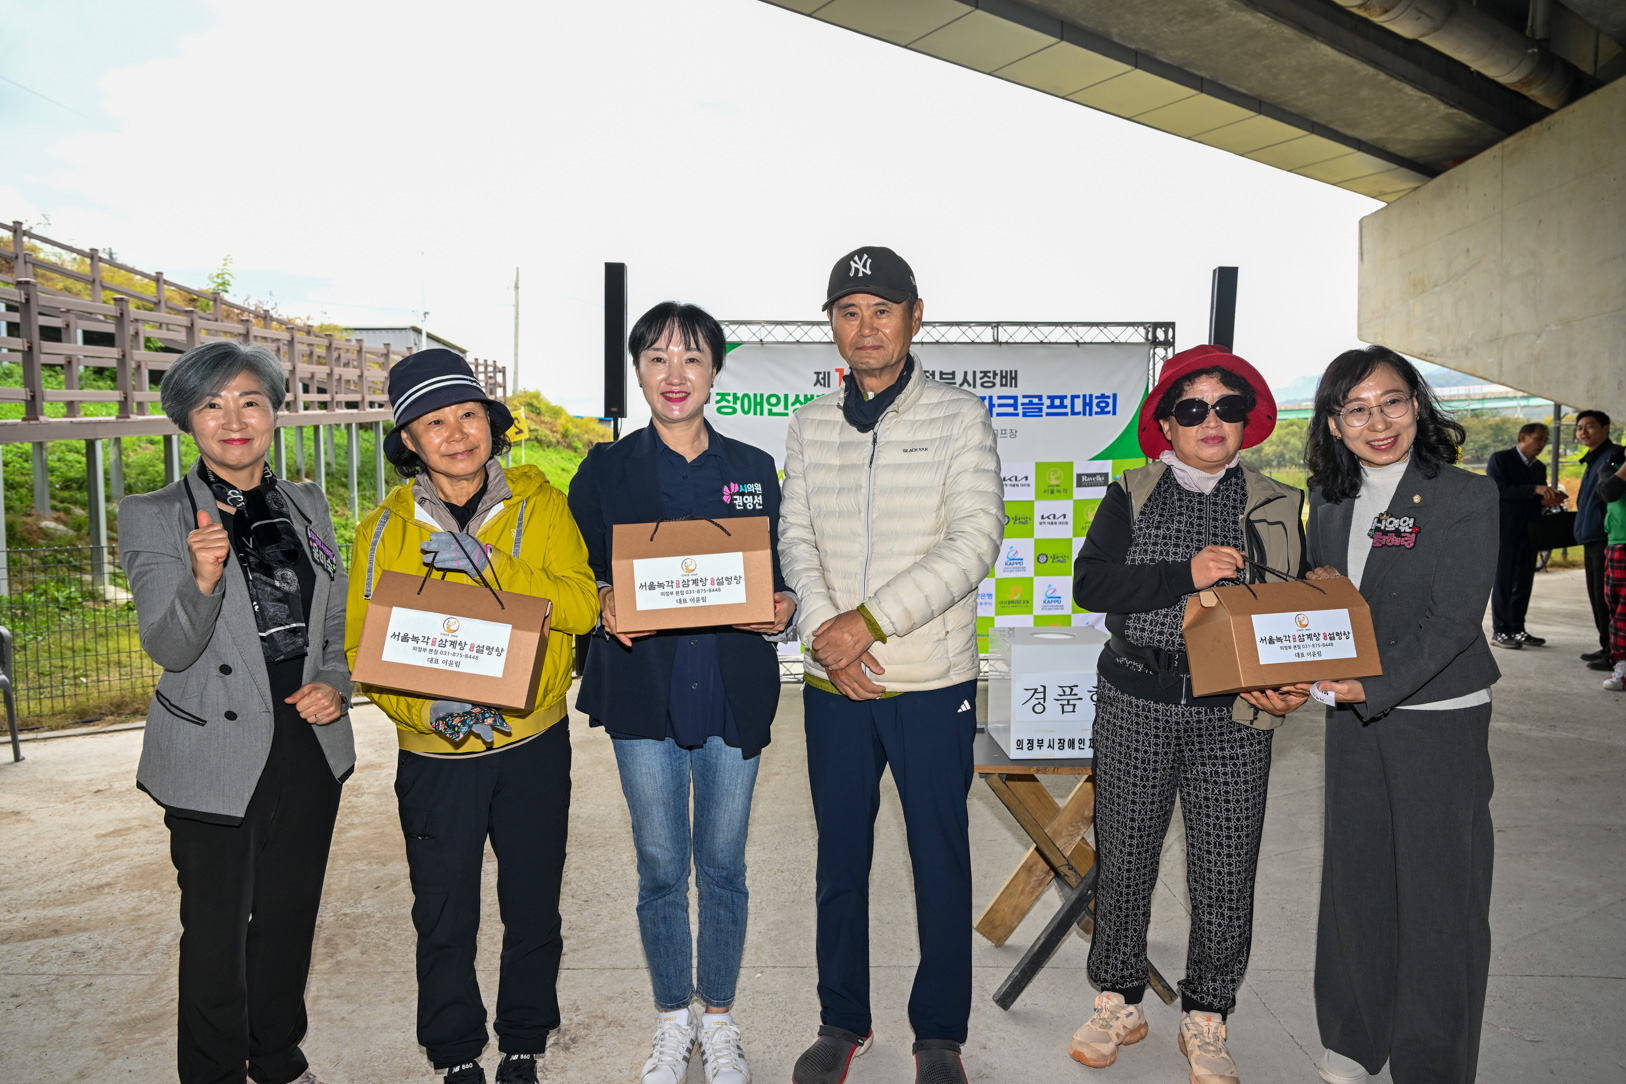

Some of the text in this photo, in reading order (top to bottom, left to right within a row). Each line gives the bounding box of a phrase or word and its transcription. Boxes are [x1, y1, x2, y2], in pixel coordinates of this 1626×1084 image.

[740, 482, 762, 494] 시의원
[733, 494, 763, 510] 권영선
[1372, 516, 1414, 532] 시의원
[639, 580, 674, 590] 서울녹각
[682, 578, 708, 588] 삼계탕
[716, 576, 742, 586] 설렁탕
[390, 632, 430, 645] 서울녹각
[438, 638, 468, 651] 삼계탕
[476, 643, 505, 657] 설렁탕
[1260, 634, 1291, 645] 서울녹각
[1297, 632, 1321, 642] 삼계탕
[1328, 631, 1351, 641] 설렁탕
